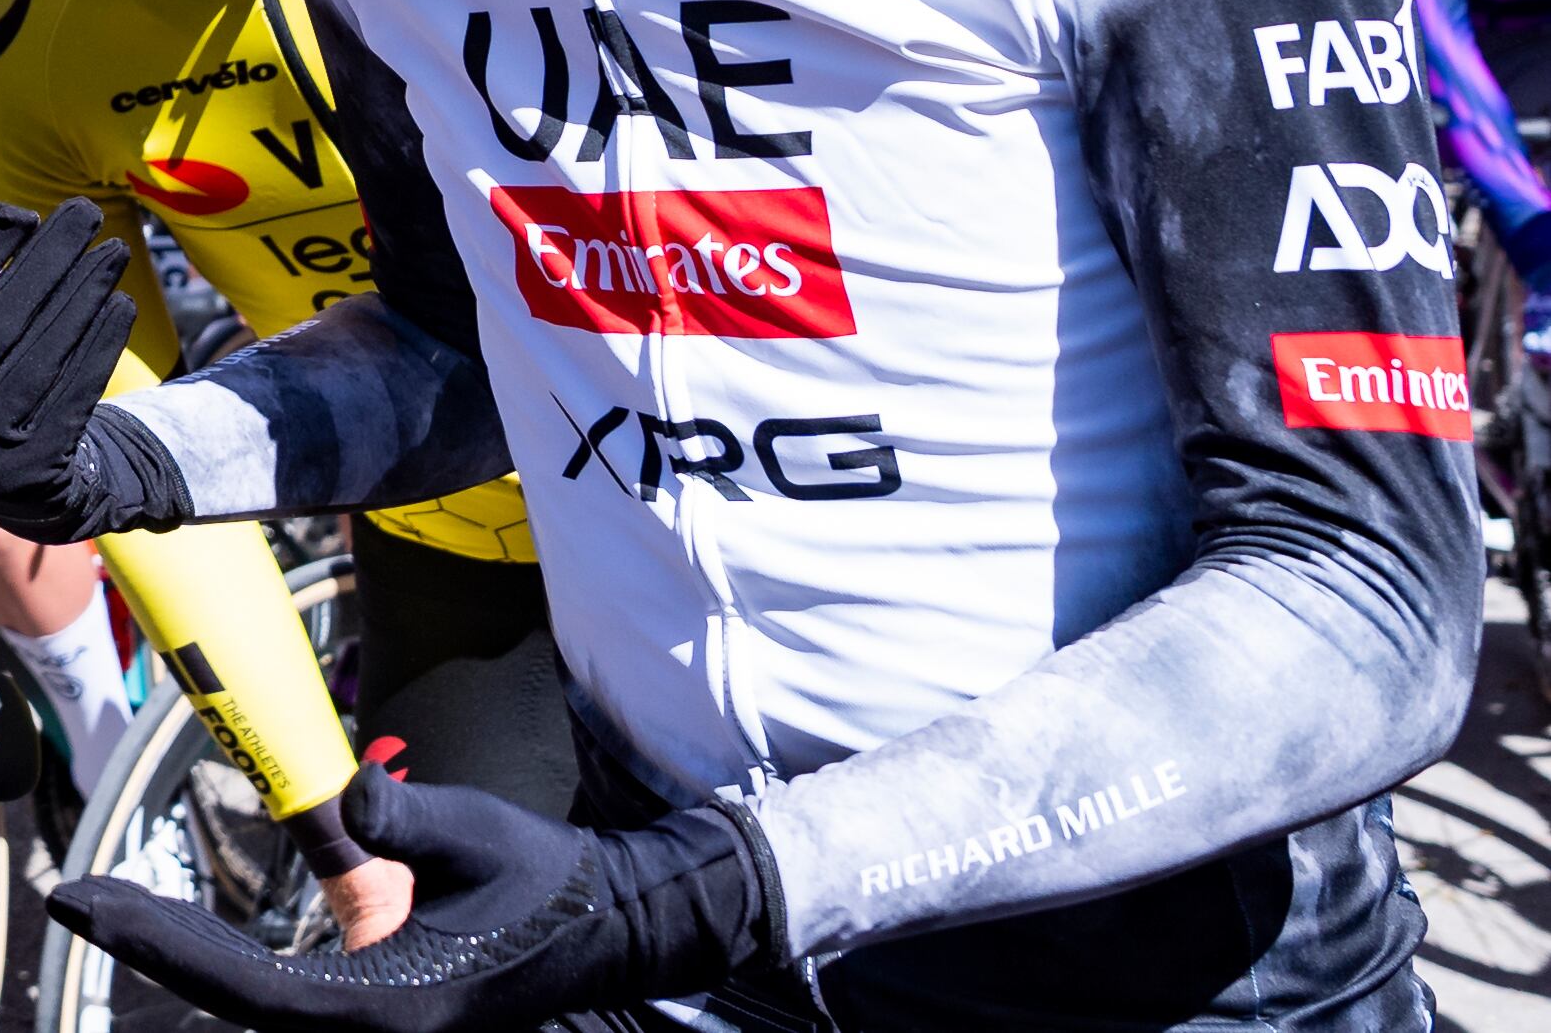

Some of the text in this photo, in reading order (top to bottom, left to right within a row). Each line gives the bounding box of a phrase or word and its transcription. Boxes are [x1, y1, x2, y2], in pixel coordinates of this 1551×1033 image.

[110, 58, 279, 114] cervélo
[463, 0, 813, 162] UAE
[523, 222, 804, 297] Emirates
[549, 390, 903, 502] XRG
[199, 705, 272, 795] FOOD
[222, 697, 248, 724] THE
[860, 758, 1188, 899] RICHARD MILLE
